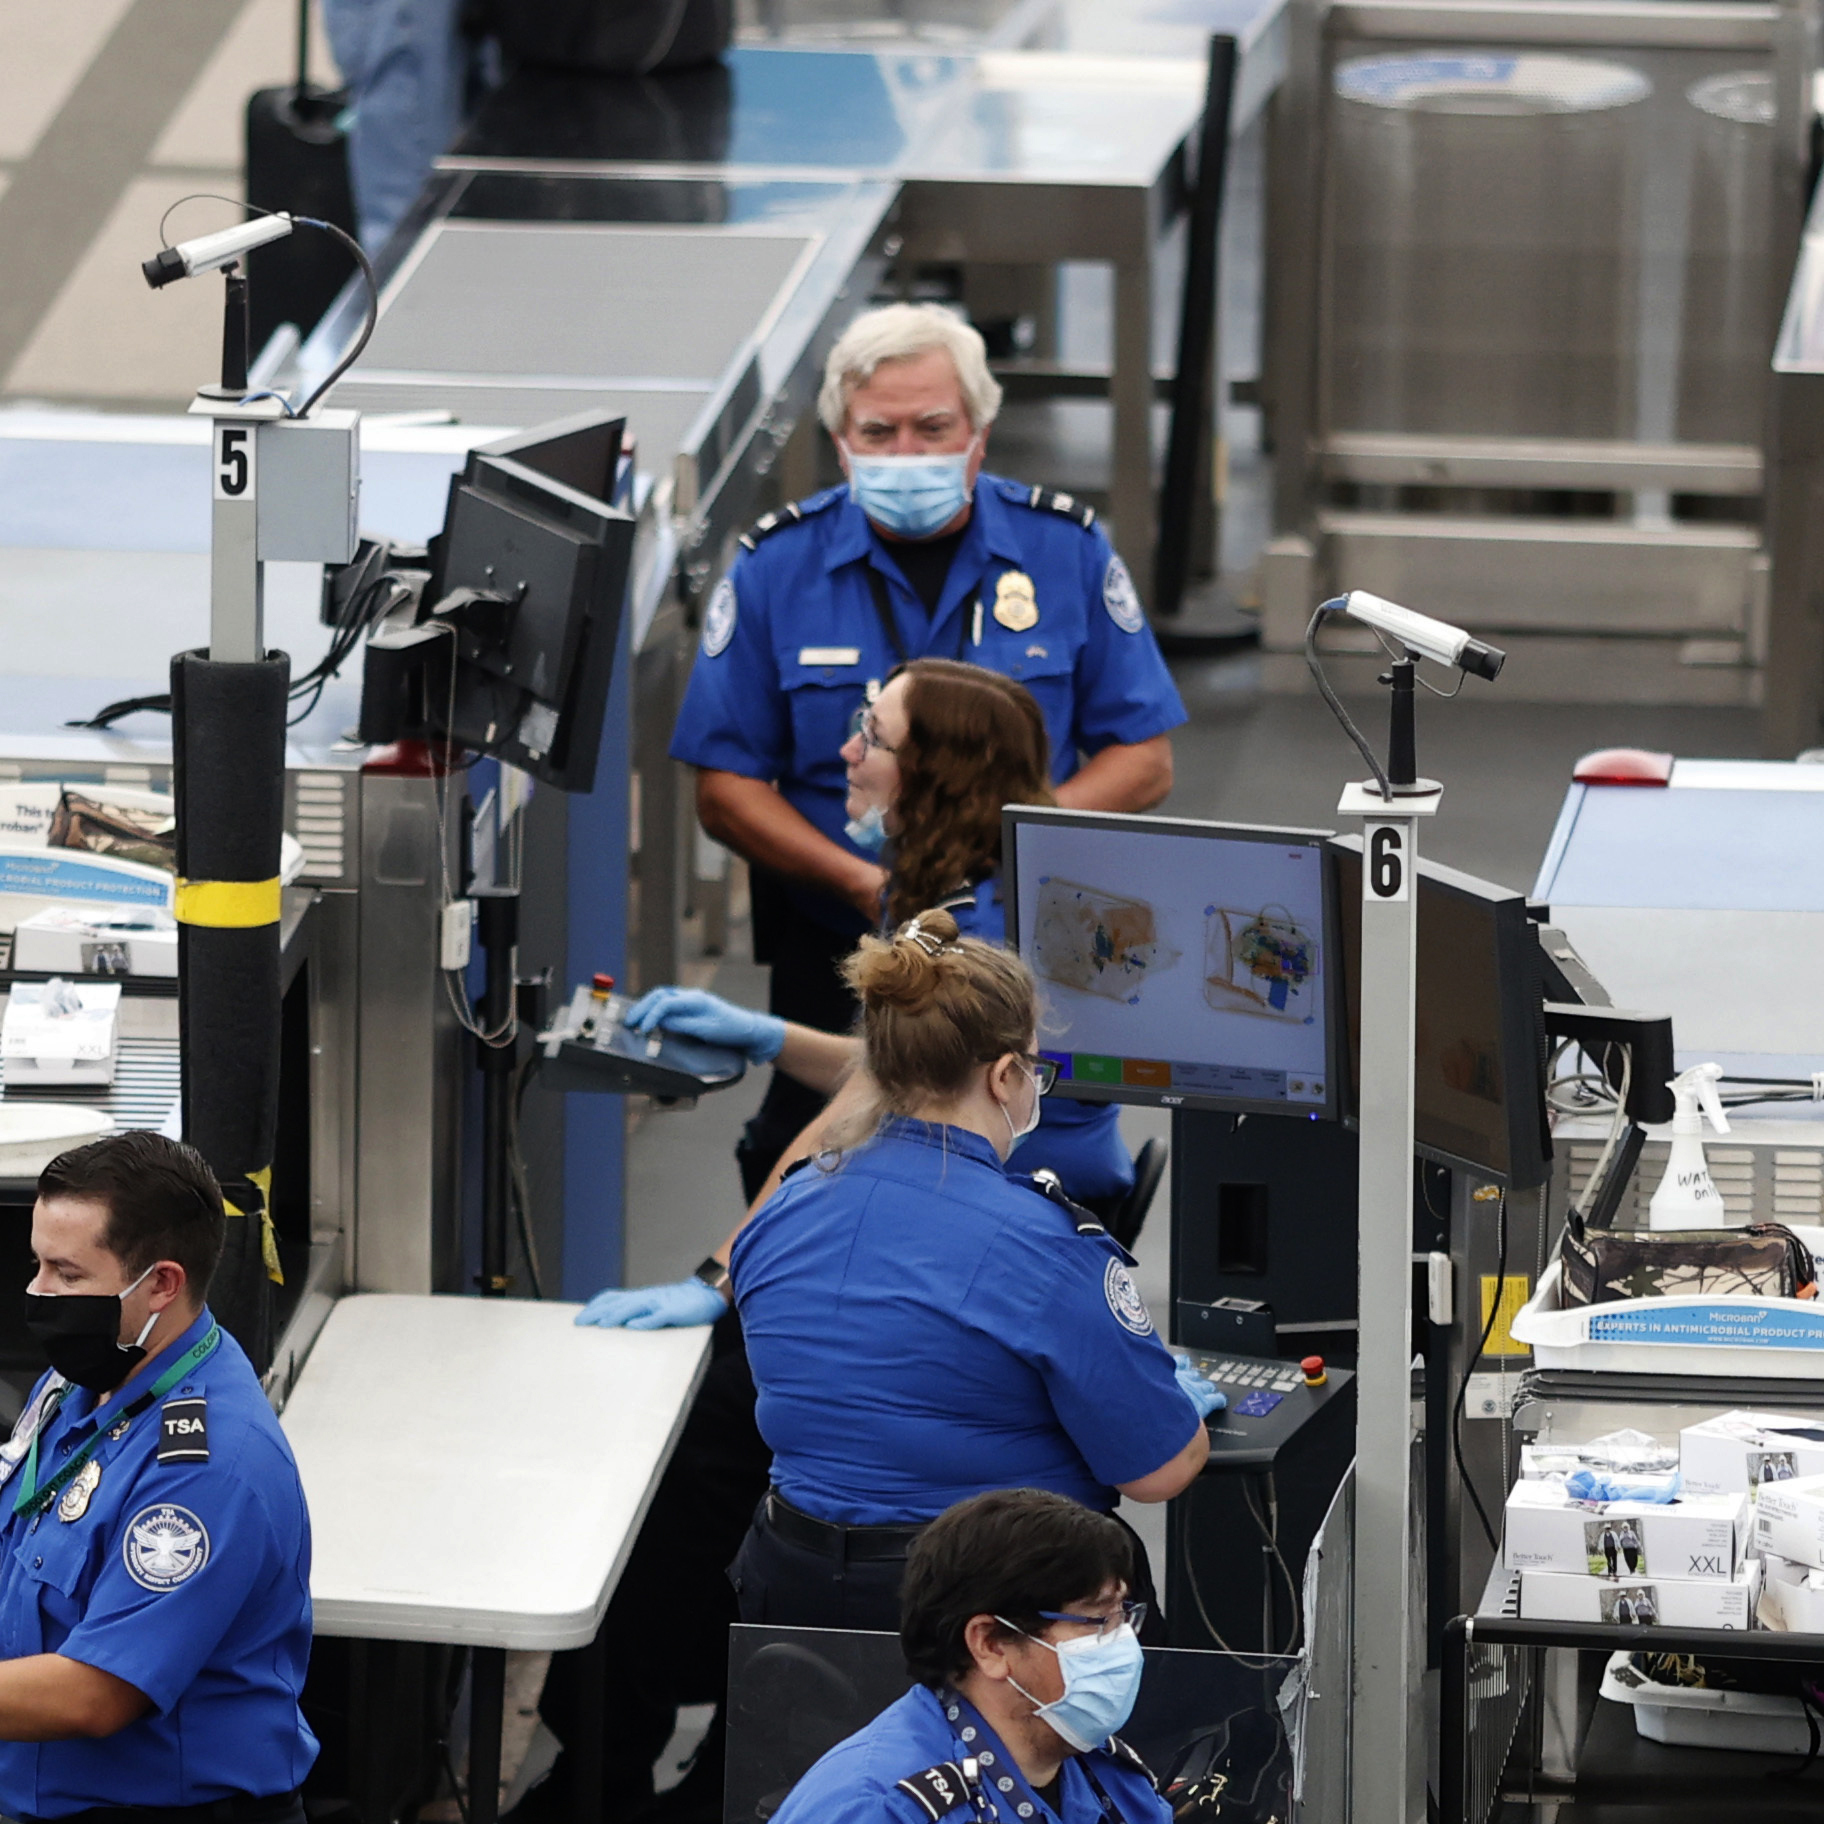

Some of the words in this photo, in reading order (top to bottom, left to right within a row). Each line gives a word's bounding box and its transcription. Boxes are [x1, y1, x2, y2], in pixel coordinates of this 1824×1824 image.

[220, 429, 248, 496] 5
[1370, 827, 1401, 898] 6
[1161, 1095, 1184, 1104] acer
[1597, 1321, 1646, 1333] EXPERTS
[1649, 1323, 1661, 1333] IN
[1664, 1324, 1750, 1337] ANTIMICROBIAL
[1753, 1327, 1805, 1339] PRODUCT
[164, 1417, 205, 1436] TSA
[1688, 1555, 1726, 1574] XXL
[924, 1768, 956, 1806] TSA
